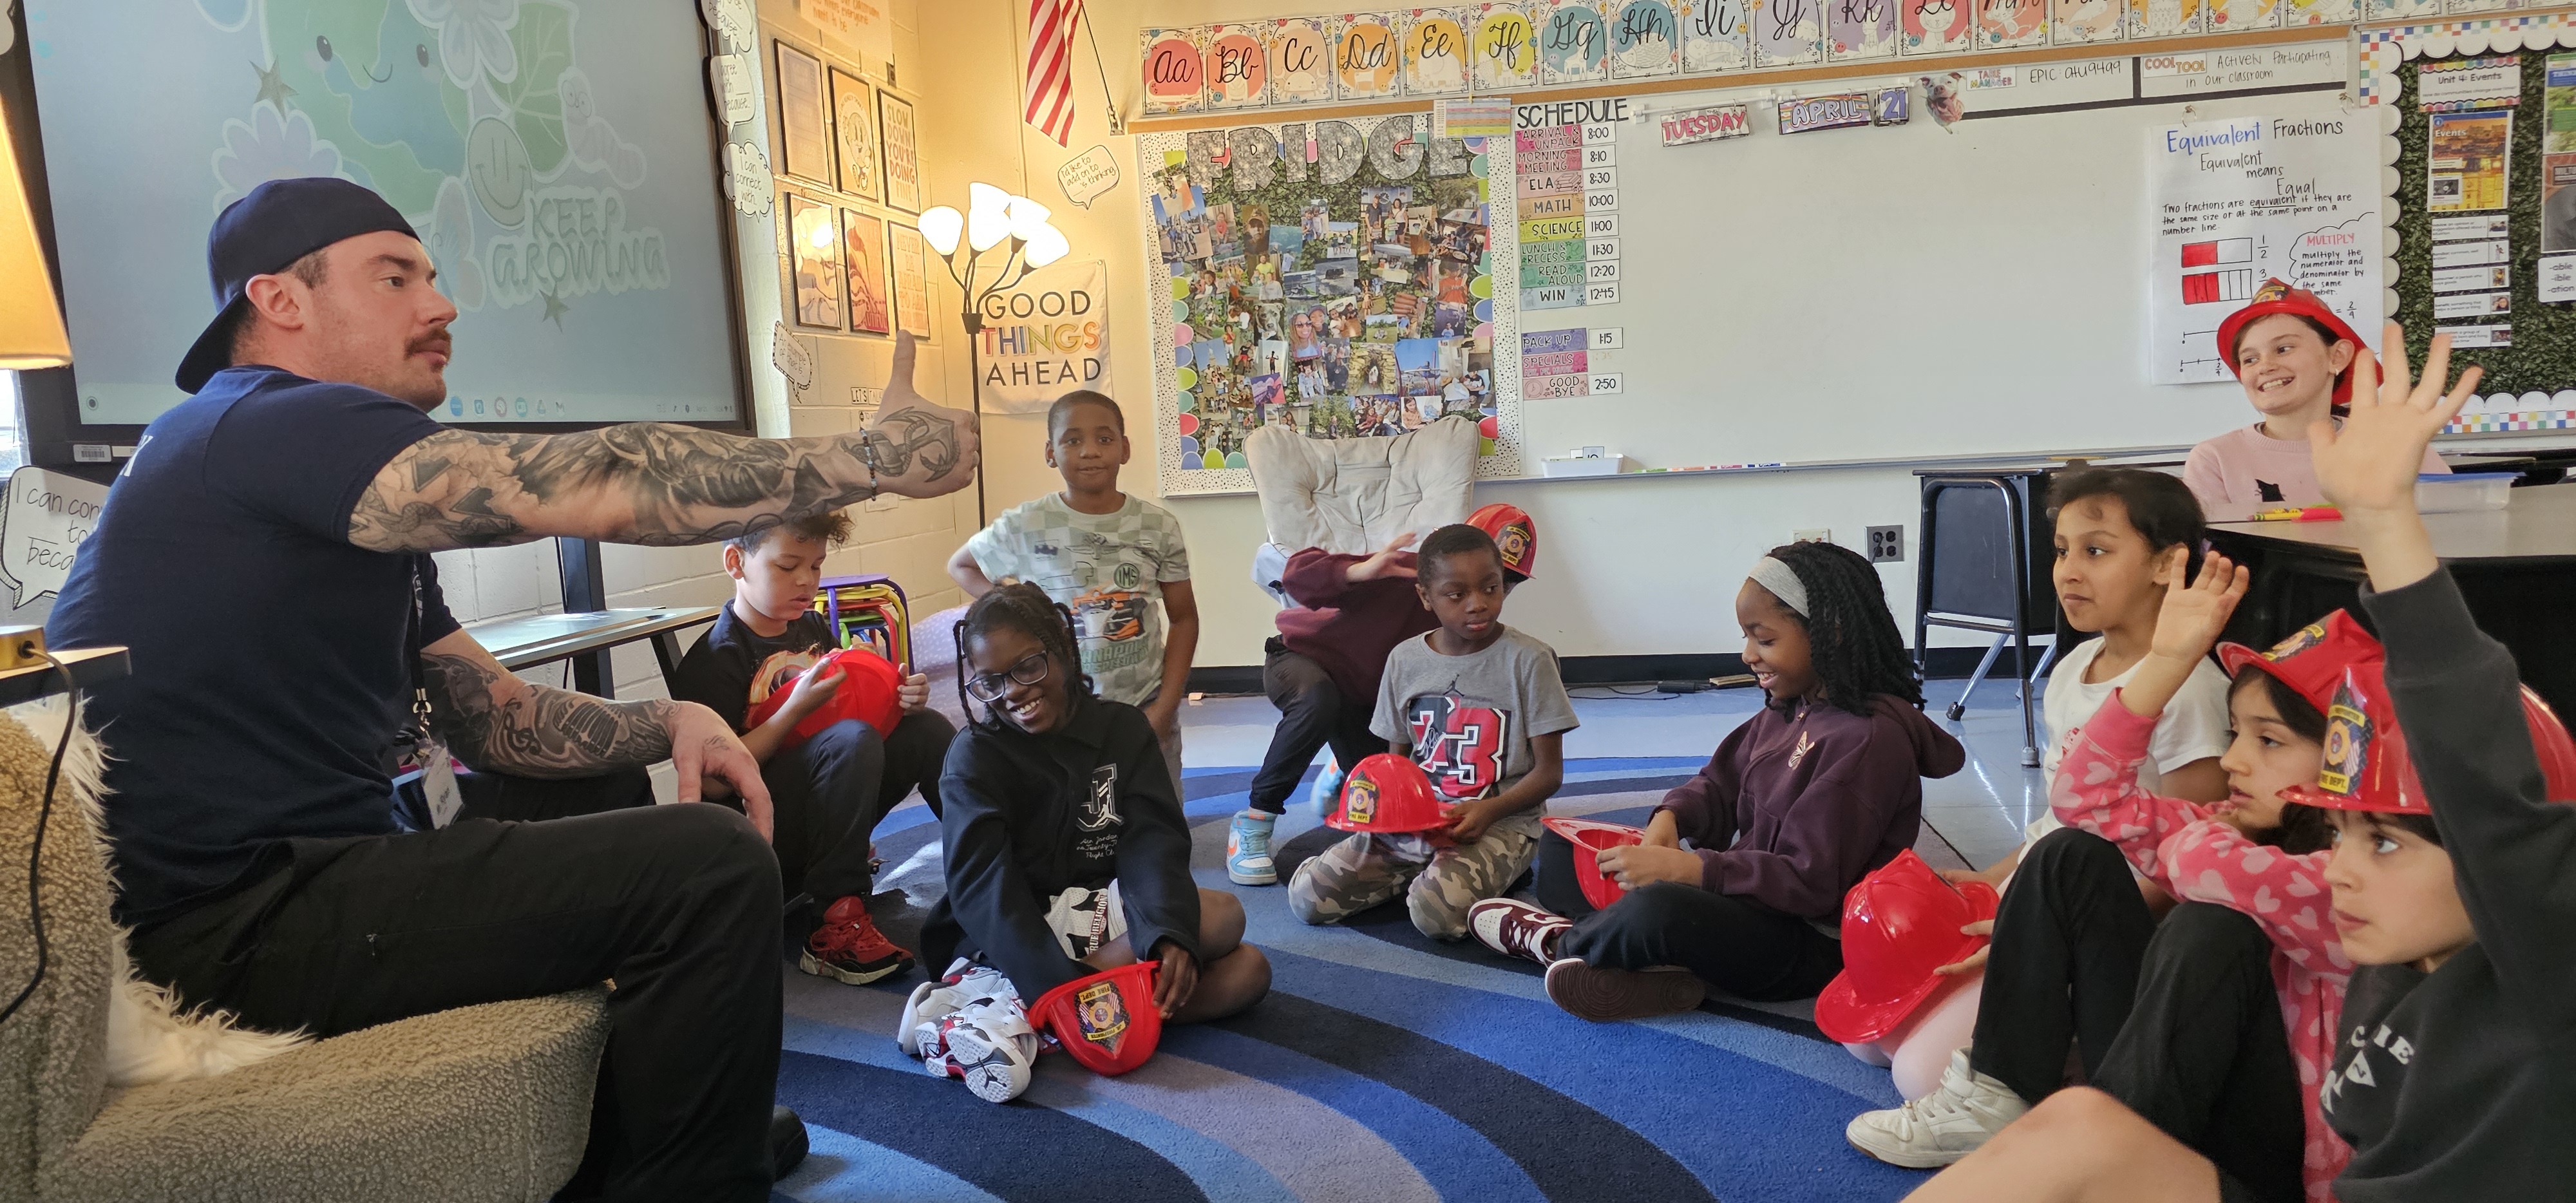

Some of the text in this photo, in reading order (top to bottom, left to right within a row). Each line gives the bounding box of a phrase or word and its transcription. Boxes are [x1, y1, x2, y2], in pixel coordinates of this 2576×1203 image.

[1620, 8, 1670, 45] Hh
[1421, 23, 1454, 59] Ee
[1548, 12, 1598, 61] Gg
[1343, 33, 1392, 70] Dd
[1488, 21, 1522, 70] Ff
[1284, 37, 1318, 72] Cc
[1153, 50, 1195, 83] Aa
[1215, 46, 1259, 84] Bb
[2145, 57, 2206, 73] COOL TOOL
[1978, 69, 2001, 79] TABLE
[2186, 70, 2273, 88] in our classroom
[2438, 75, 2456, 84] Unit
[2470, 72, 2502, 82] Events
[1970, 77, 2012, 89] MANAGER
[1880, 89, 1906, 120] 21
[886, 103, 909, 129] SLOW
[1517, 98, 1629, 129] SCHEDULE
[1791, 99, 1862, 128] APRIL
[1522, 126, 1580, 140] ARRIVAL &
[1587, 126, 1609, 140] 8:00
[1661, 111, 1747, 142] TUESDAY
[2435, 129, 2467, 137] Events
[887, 122, 911, 148] DOWN
[2166, 118, 2344, 156] Equivalent Fractions
[1535, 136, 1579, 150] UNPACK
[886, 140, 915, 168] YOU'RE
[1187, 113, 1468, 194] FRIDGE
[1518, 149, 1567, 163] MORNING
[1590, 150, 1607, 162] 8:10
[744, 160, 758, 175] can
[1069, 162, 1083, 173] like
[1081, 156, 1092, 166] to
[1524, 161, 1567, 173] MEETING
[2200, 150, 2263, 173] Equivalent
[889, 161, 916, 184] DOING
[1067, 164, 1099, 186] add on to
[1088, 166, 1117, 185] thinking
[1589, 172, 1611, 184] 8:30
[2246, 166, 2284, 178] means
[735, 172, 762, 191] connect
[1529, 176, 1554, 191] ELA
[2277, 177, 2316, 196] Equal
[1533, 198, 1571, 214] MATH
[1589, 194, 1614, 207] 10:00
[2162, 203, 2181, 213] Two
[2184, 200, 2224, 213] fractions
[2228, 200, 2244, 208] are
[2249, 193, 2297, 209] equivalent
[2302, 194, 2309, 203] if
[2314, 193, 2332, 203] they
[530, 196, 624, 240] KEEP
[2162, 216, 2175, 225] the
[2268, 207, 2290, 216] same
[2293, 205, 2314, 216] point
[1531, 220, 1583, 236] SCIENCE
[1591, 220, 1613, 232] 11:00
[2161, 227, 2196, 236] number
[2306, 232, 2355, 247] MULTIPLY
[1521, 242, 1566, 254] LUNCH &
[1592, 243, 1613, 256] 11:30
[2260, 249, 2268, 259] 2
[2302, 251, 2340, 260] multiply
[490, 236, 666, 287] GROWING
[1527, 251, 1566, 264] RECESS
[2300, 256, 2363, 269] numerator and
[1539, 265, 1567, 276] READ
[1590, 265, 1615, 278] 12:20
[2259, 268, 2267, 278] 3
[2300, 267, 2365, 279] denominator by
[2549, 262, 2573, 270] -able
[1548, 274, 1584, 285] ALOUD
[2302, 281, 2316, 289] the
[1539, 289, 1566, 302] WIN
[1590, 287, 1615, 300] 12:45
[2547, 285, 2575, 293] -ation
[985, 290, 1091, 320] GOOD
[981, 321, 1101, 355] THINGS
[1522, 334, 1571, 348] PACK UP
[1599, 332, 1613, 345] 1:15
[1523, 354, 1573, 368] SPECIALS
[986, 357, 1101, 386] AHEAD
[1549, 375, 1580, 388] GOOD
[1595, 378, 1616, 390] 2:50
[851, 388, 867, 403] LET'S
[1555, 386, 1575, 397] BYE
[26, 487, 63, 513] can
[68, 498, 102, 520] con
[26, 537, 77, 572] beca
[1092, 895, 1108, 933] RELIGION
[1080, 985, 1110, 1001] FIRE DEPT.
